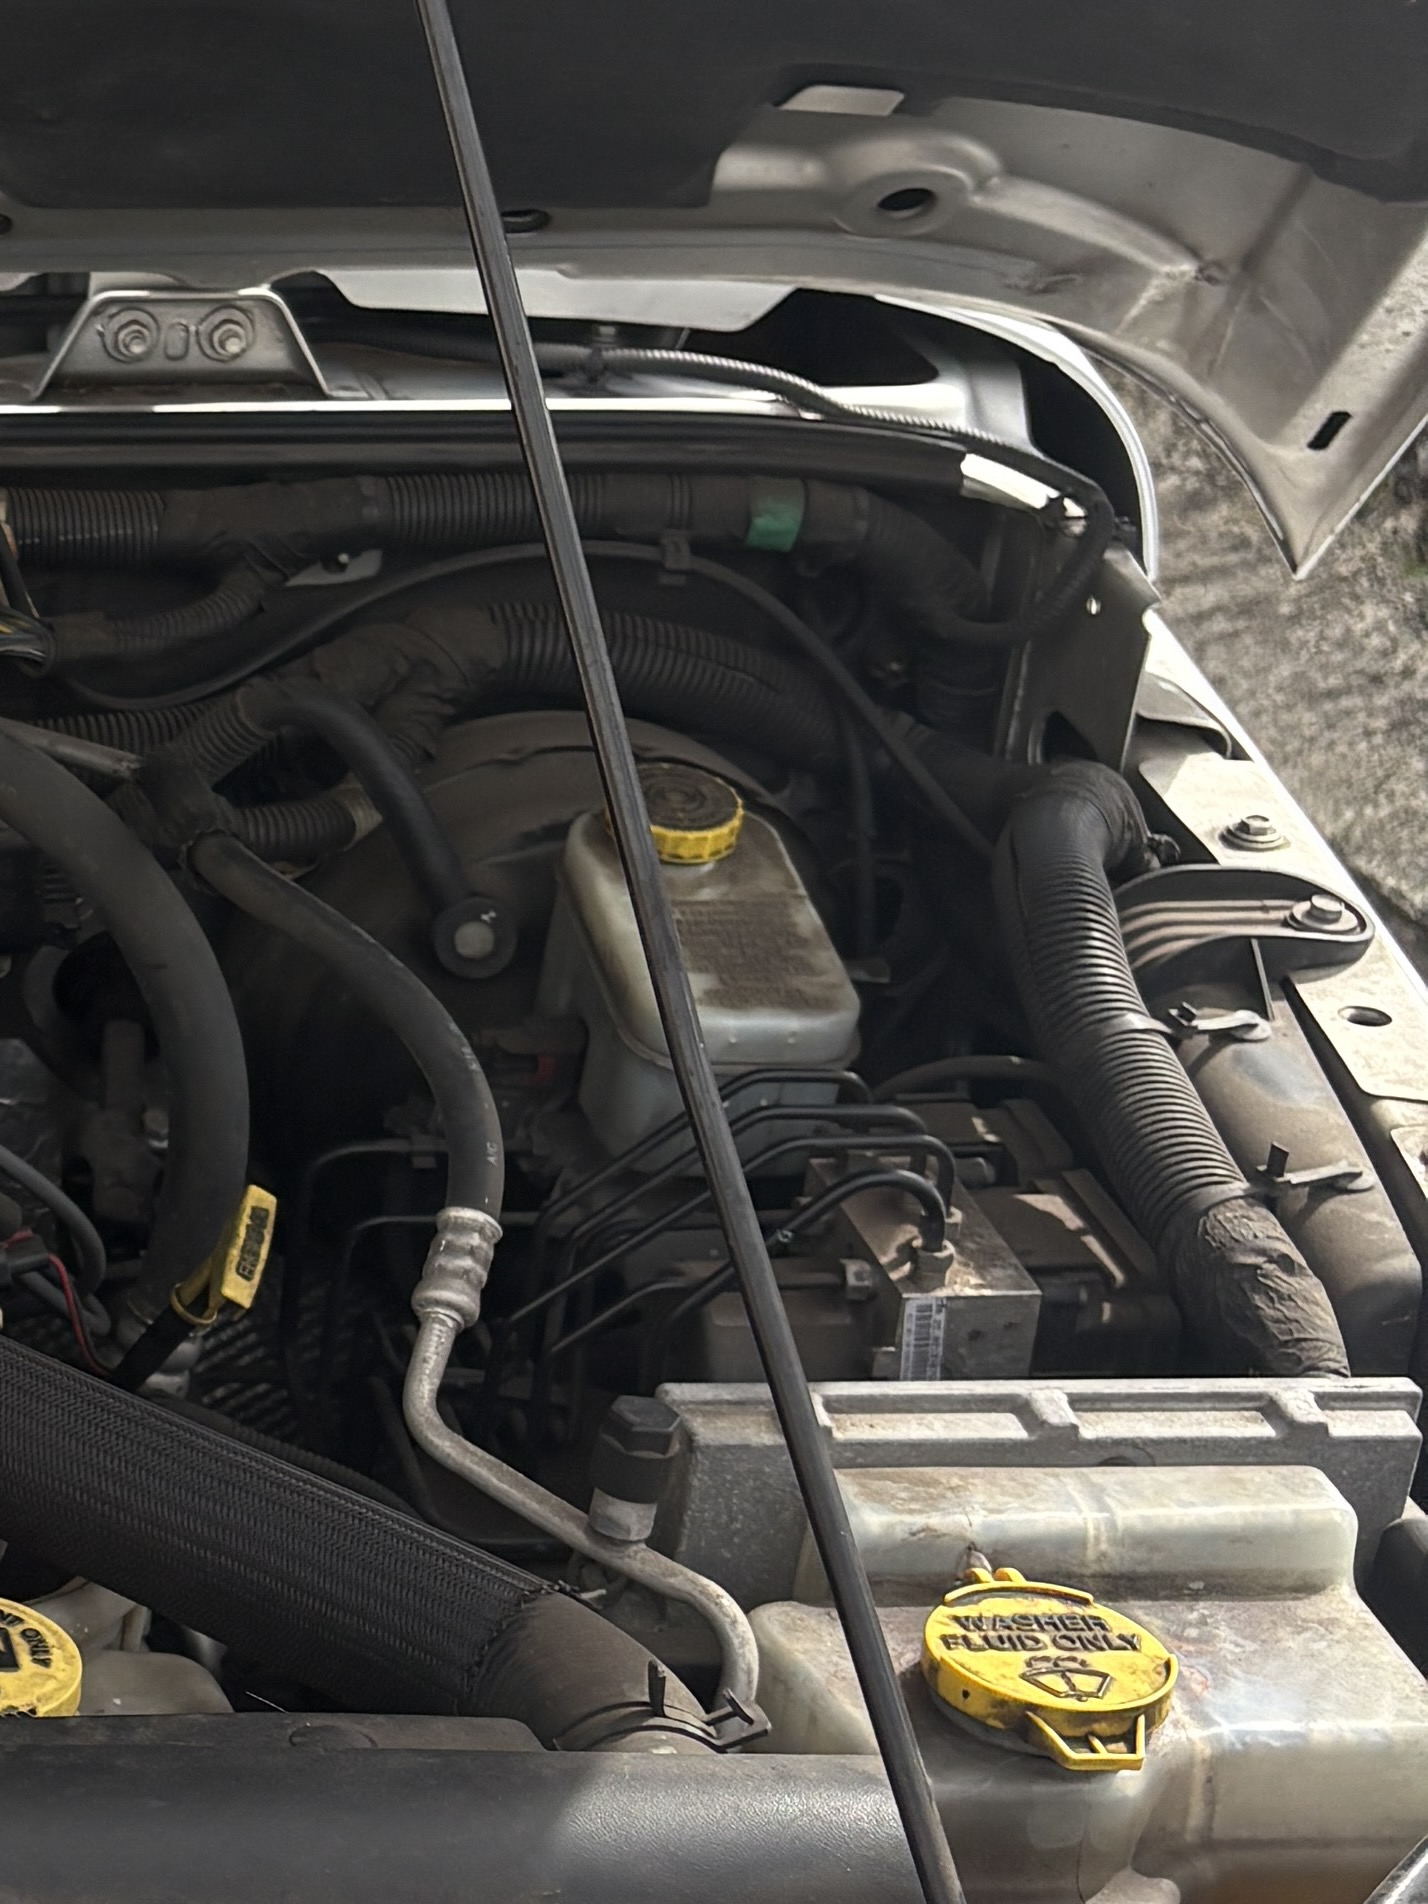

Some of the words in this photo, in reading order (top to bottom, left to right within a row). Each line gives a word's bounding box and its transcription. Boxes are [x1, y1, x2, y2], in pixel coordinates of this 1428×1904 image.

[950, 1612, 1113, 1634] WASHER
[19, 1627, 53, 1668] ONLY
[939, 1633, 1048, 1652] FLUID
[1051, 1632, 1142, 1652] ONLY
